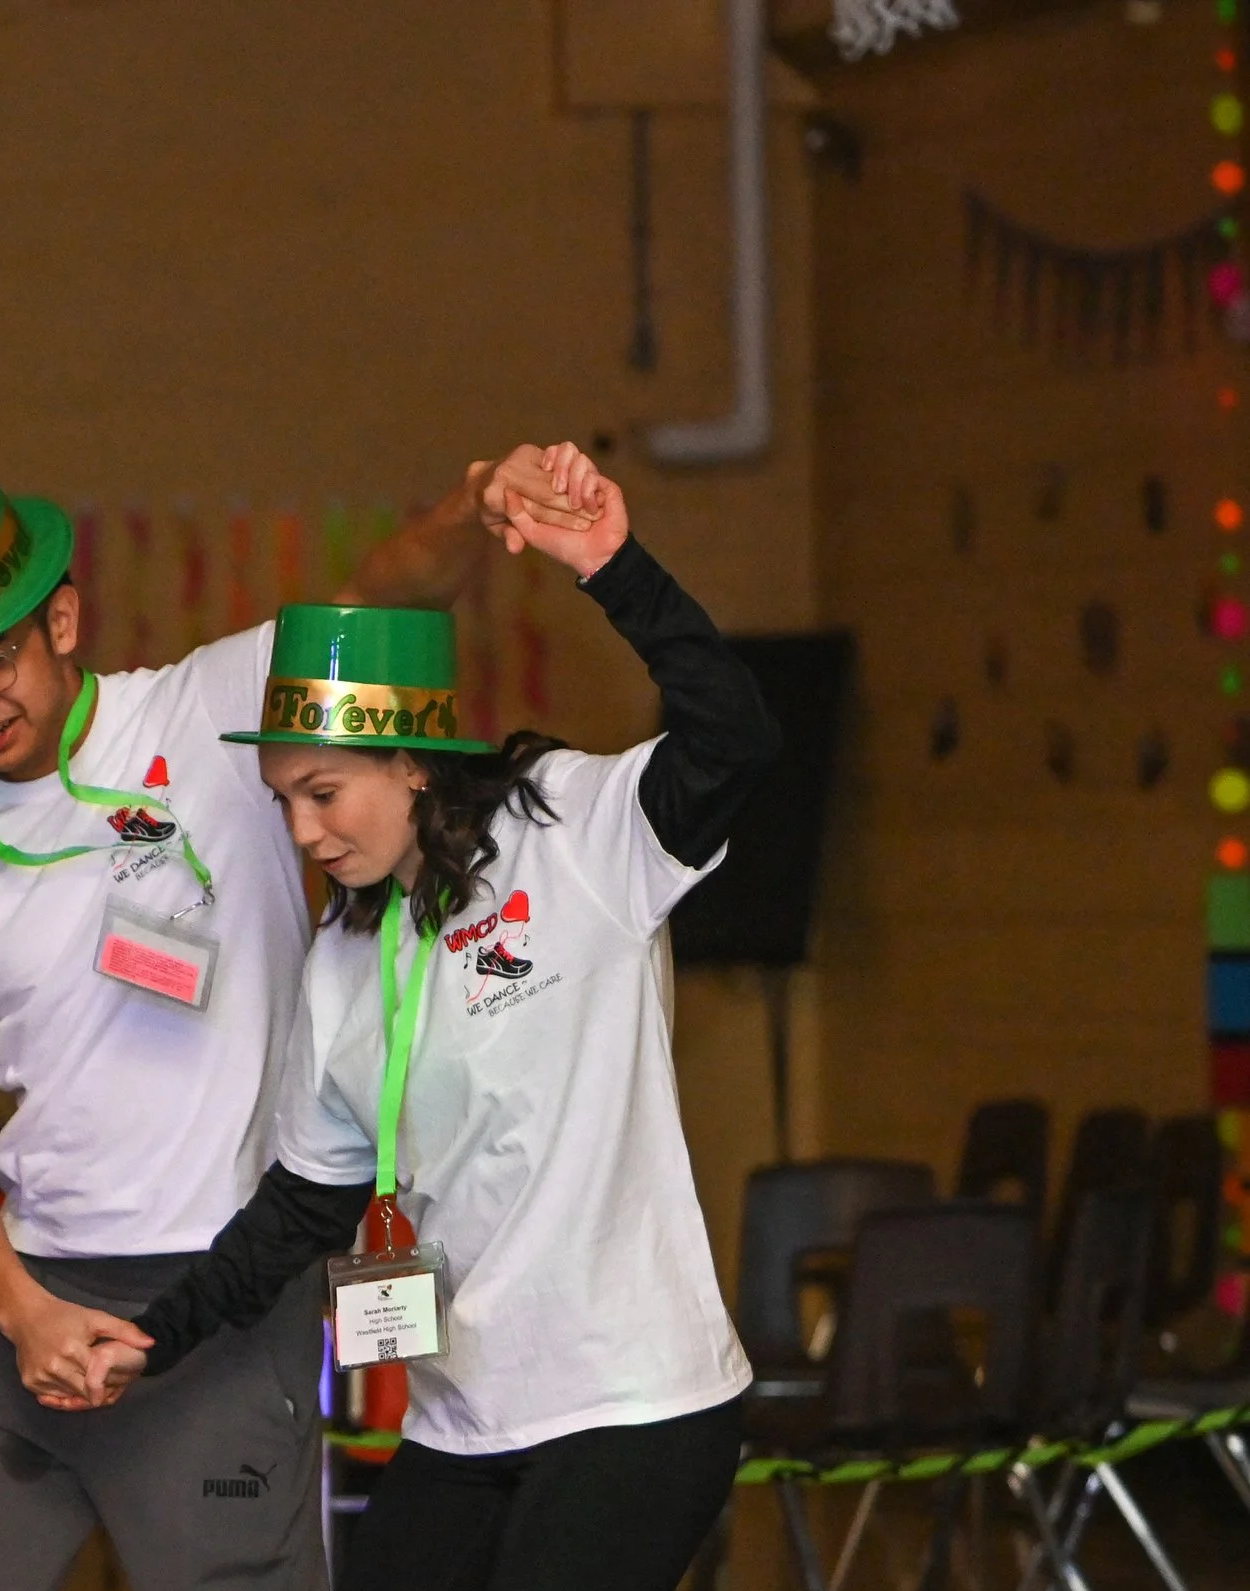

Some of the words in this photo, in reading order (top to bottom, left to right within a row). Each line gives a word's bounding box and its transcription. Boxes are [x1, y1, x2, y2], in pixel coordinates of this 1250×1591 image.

[269, 684, 438, 737] Forever
[113, 868, 130, 883] WE
[444, 912, 498, 953] WMCD
[466, 1003, 483, 1017] WE
[483, 981, 521, 1009] DANCE
[488, 993, 526, 1018] BECAUSE
[524, 984, 540, 998] WE
[538, 972, 564, 991] CARE
[397, 1322, 416, 1330] School
[203, 1479, 259, 1498] PUMA
